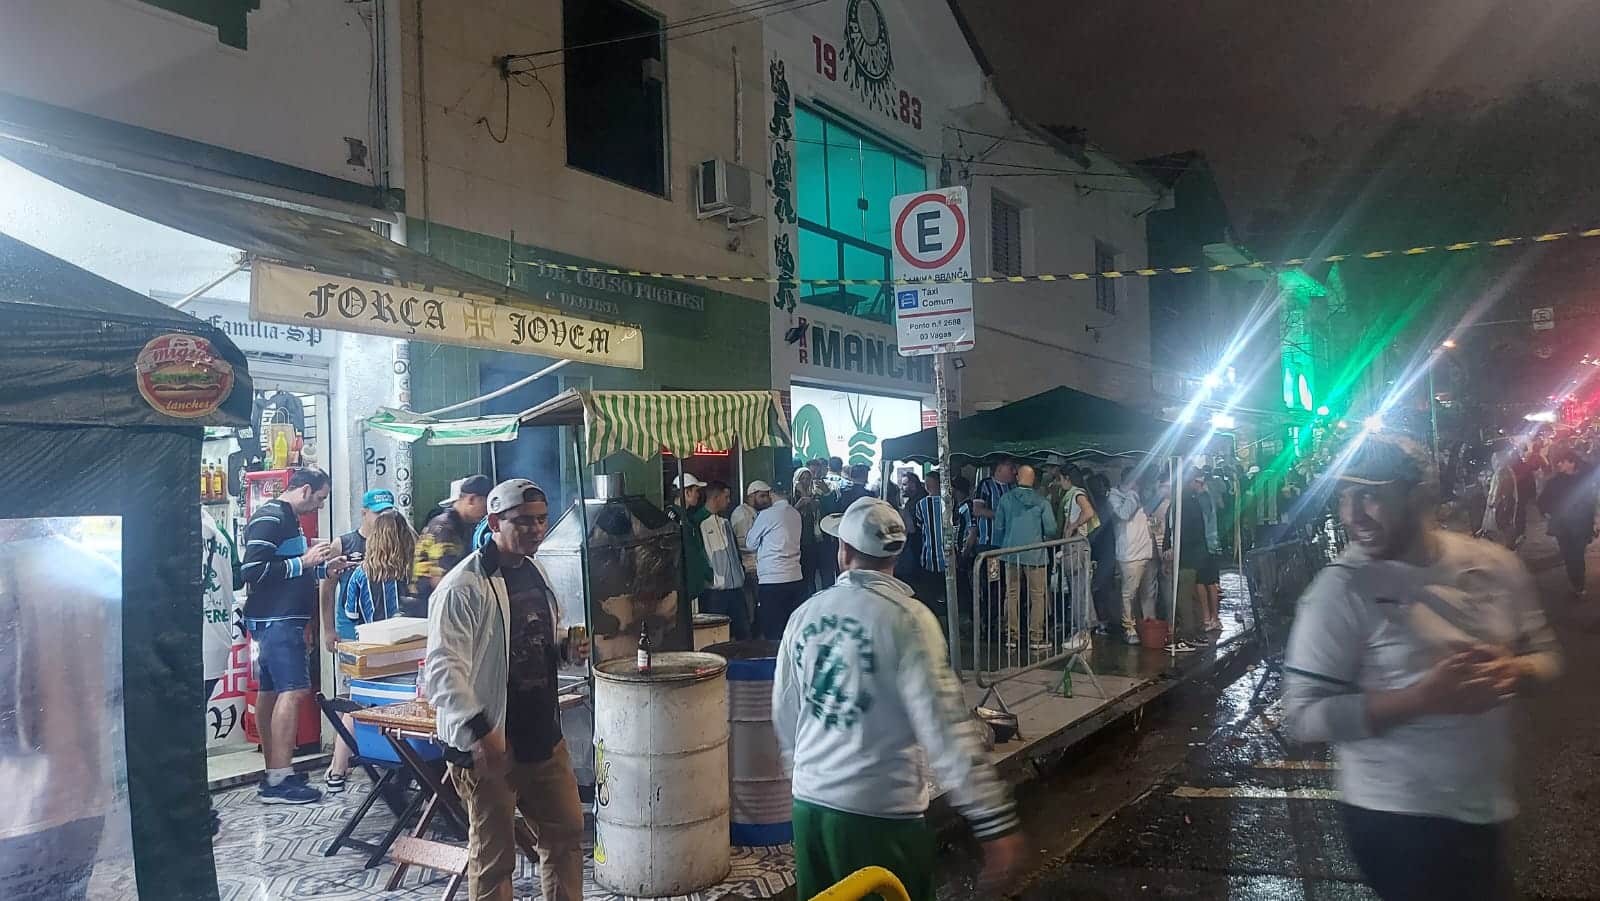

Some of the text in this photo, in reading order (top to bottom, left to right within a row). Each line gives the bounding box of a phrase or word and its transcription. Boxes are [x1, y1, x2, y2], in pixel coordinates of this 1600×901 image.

[812, 34, 837, 81] 19
[899, 89, 922, 130] 83
[916, 210, 943, 254] E
[303, 282, 610, 354] FORÇA JOVEM
[922, 298, 954, 308] Comum
[909, 322, 930, 330] Ponto
[930, 331, 952, 340] Vagas
[364, 446, 387, 476] 25
